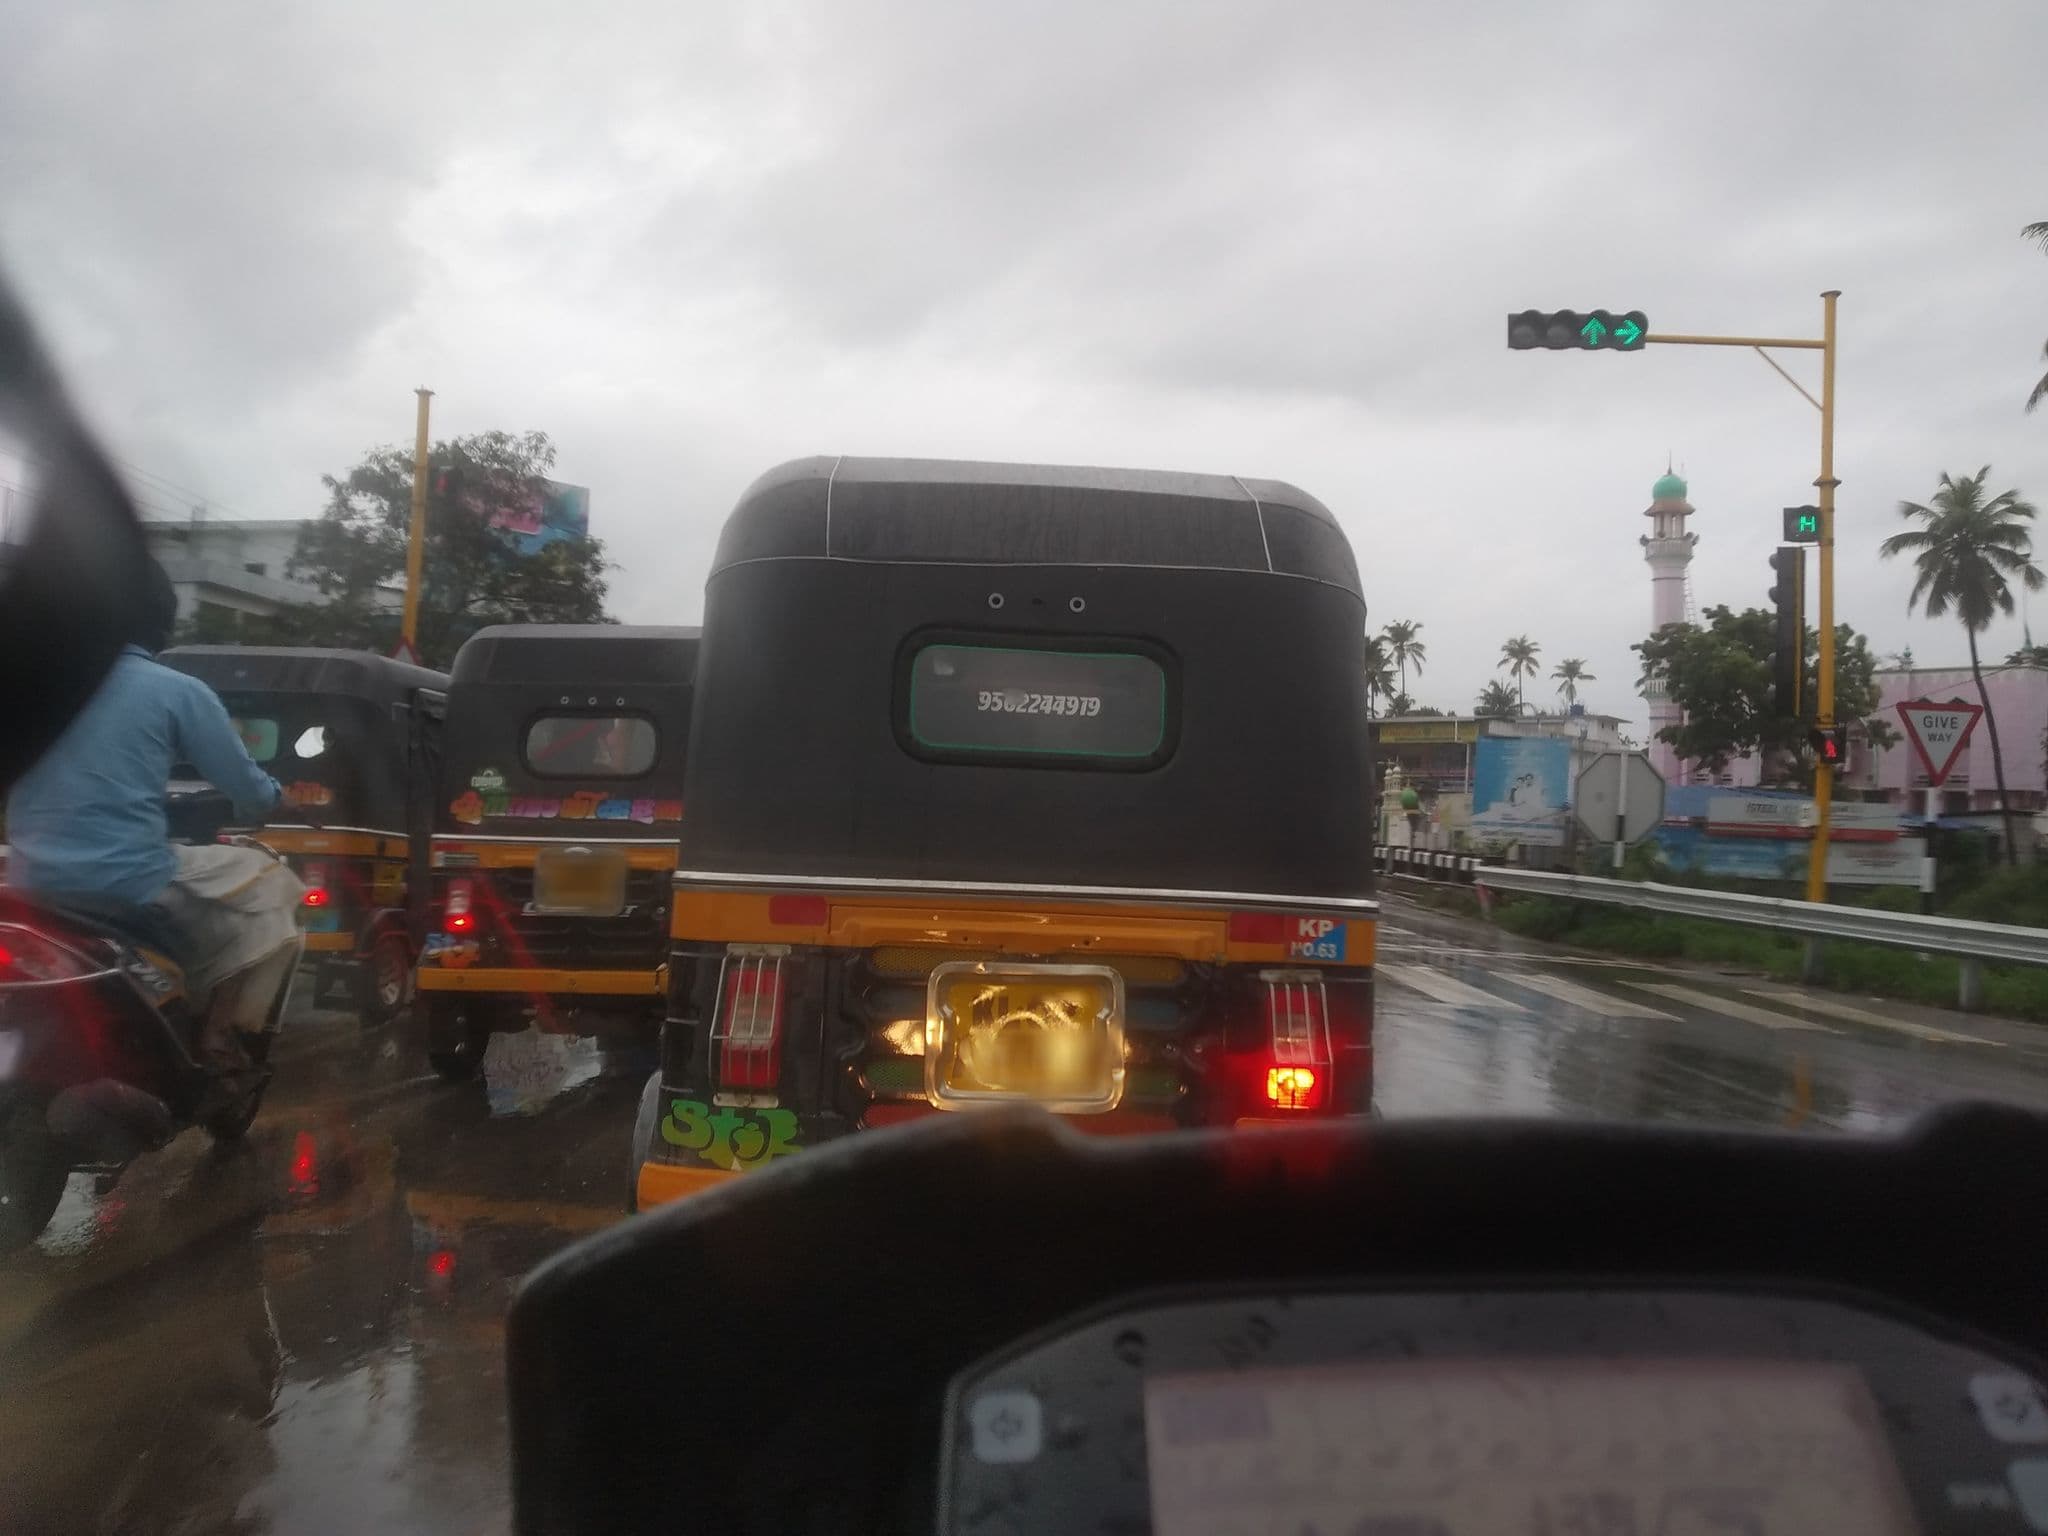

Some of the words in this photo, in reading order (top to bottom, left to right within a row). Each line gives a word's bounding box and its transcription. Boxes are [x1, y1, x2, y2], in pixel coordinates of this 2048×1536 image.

[1922, 714, 1959, 730] GIVE
[1927, 732, 1953, 743] WAY
[1299, 918, 1335, 938] KP
